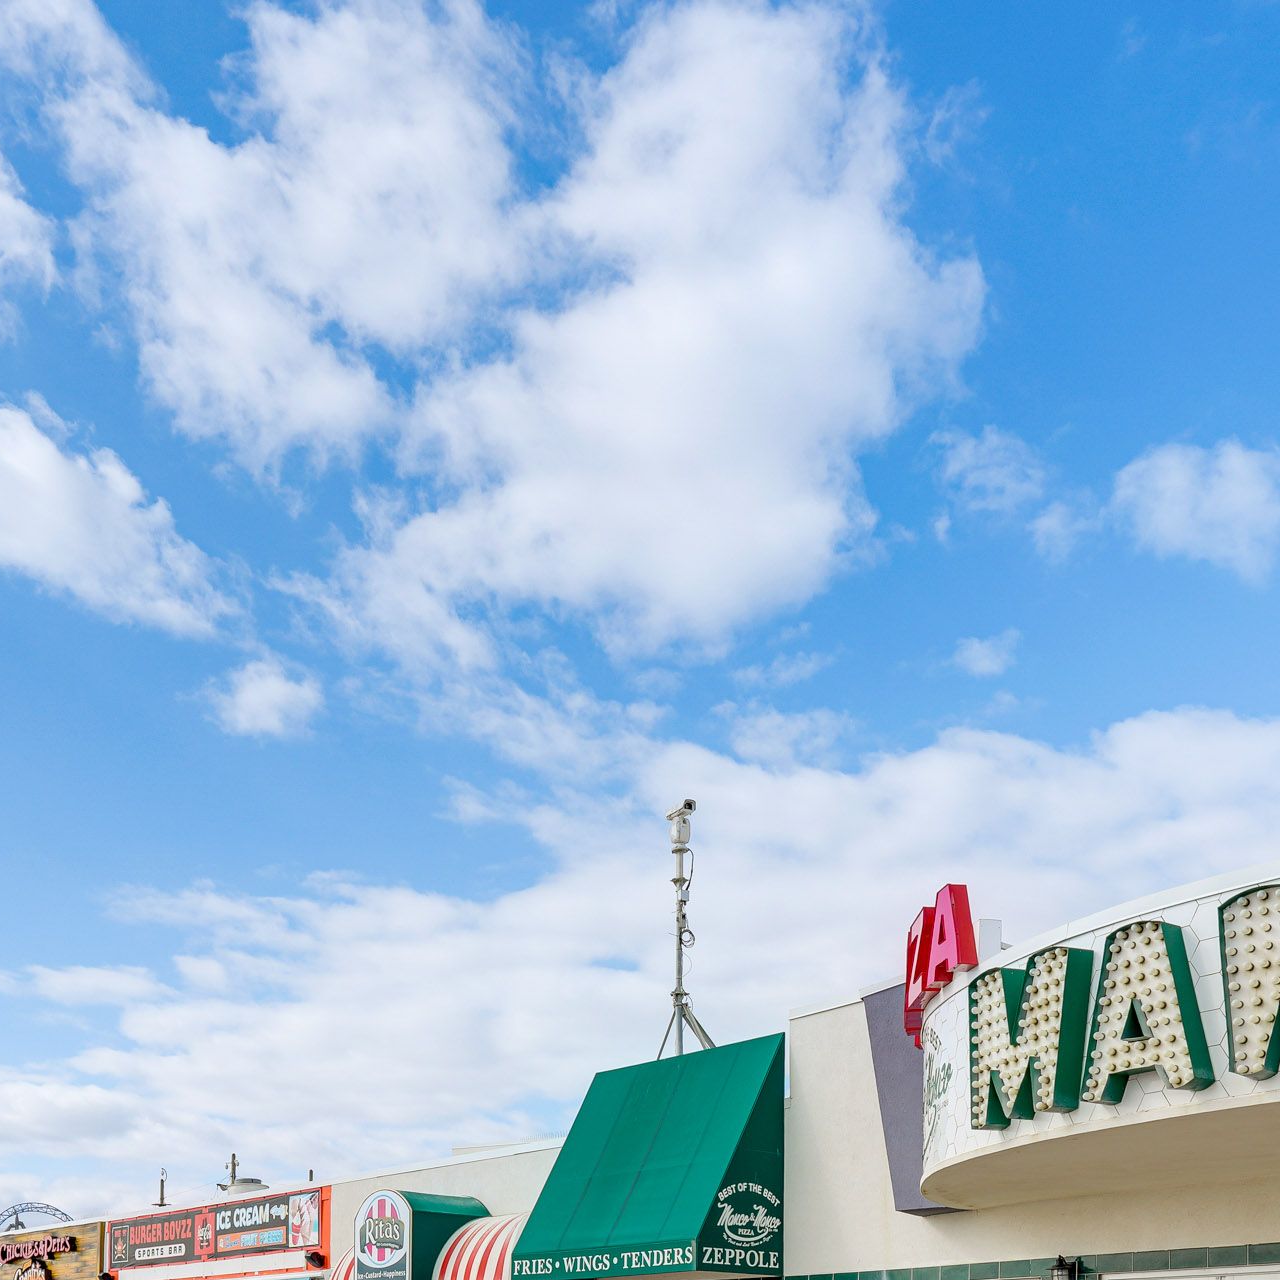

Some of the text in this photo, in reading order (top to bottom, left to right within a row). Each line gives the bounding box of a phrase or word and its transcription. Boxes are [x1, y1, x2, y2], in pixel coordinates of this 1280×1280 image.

[718, 1182, 781, 1207] BEST OF THE BEST
[216, 1210, 232, 1231] ICE
[233, 1203, 270, 1228] CREAM
[717, 1202, 782, 1230] Manco & Manco
[130, 1223, 162, 1245] BURGER
[163, 1218, 192, 1241] BOYZZ
[365, 1217, 400, 1245] Rita's
[738, 1228, 755, 1236] PIZZA
[137, 1246, 183, 1258] SPORTS BAR
[513, 1246, 693, 1276] FRIES WINGS TENDERS
[702, 1246, 780, 1269] ZEPPOLE
